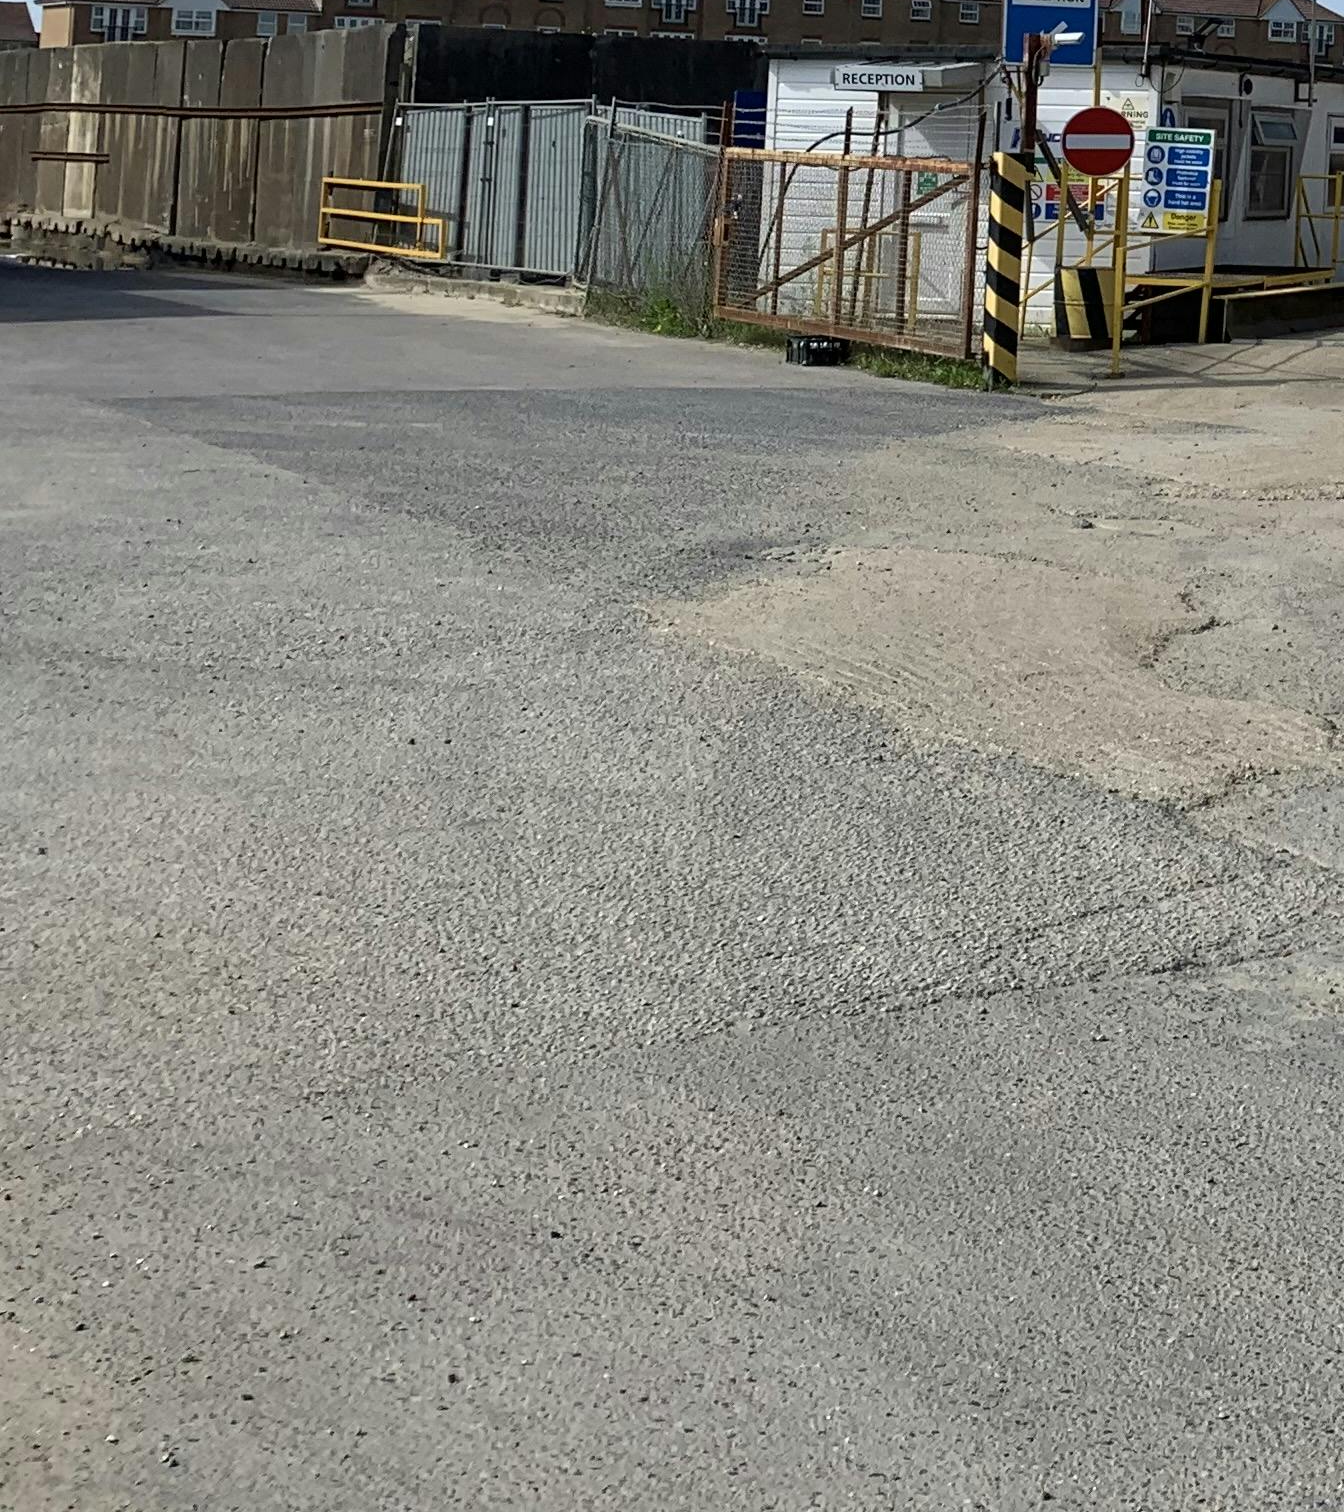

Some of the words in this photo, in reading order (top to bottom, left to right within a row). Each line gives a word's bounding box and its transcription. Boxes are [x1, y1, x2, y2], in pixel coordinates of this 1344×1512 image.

[842, 73, 915, 86] RECEPTION
[1156, 133, 1173, 141] SITE
[1174, 134, 1204, 142] SAFETY
[1171, 213, 1196, 222] Danger
